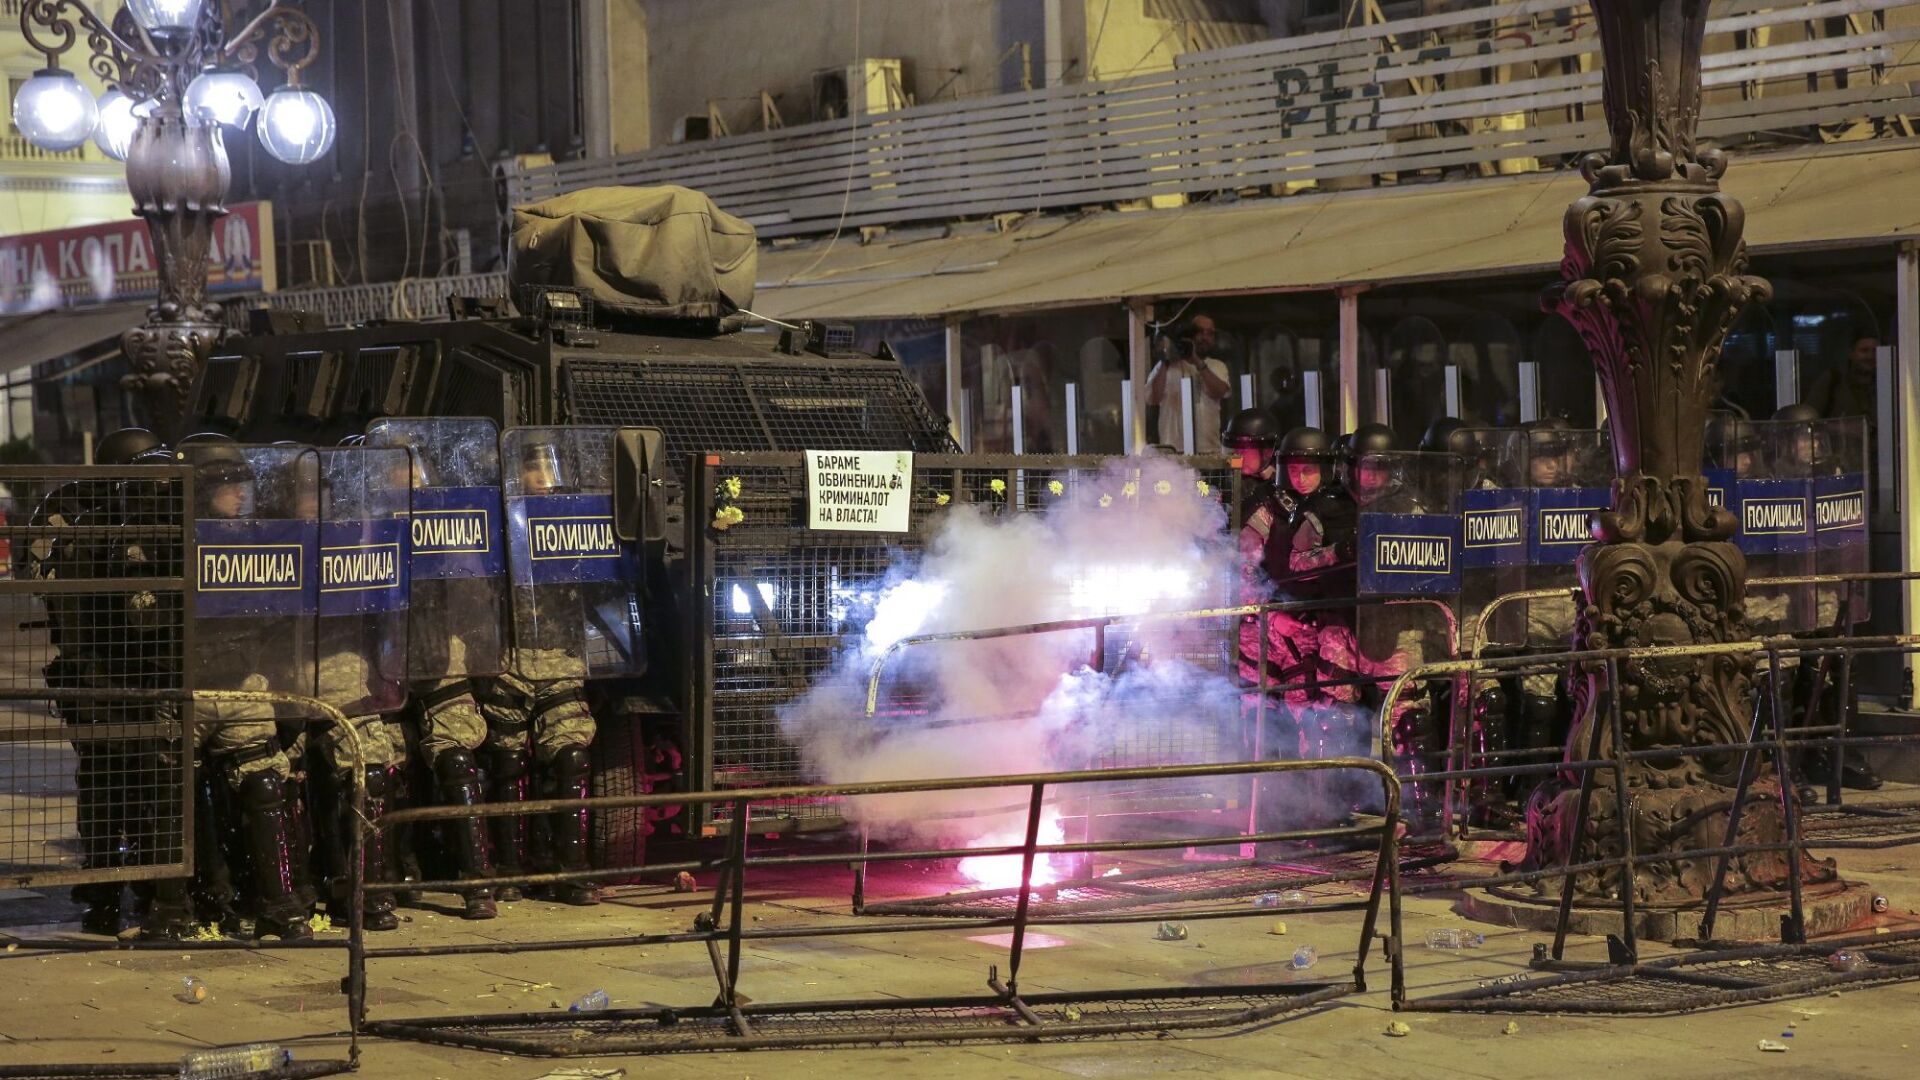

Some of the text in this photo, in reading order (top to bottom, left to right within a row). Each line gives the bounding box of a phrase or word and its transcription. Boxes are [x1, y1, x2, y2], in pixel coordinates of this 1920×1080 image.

[59, 230, 222, 279] КОПАА
[817, 455, 860, 470] БАРАМЕ
[818, 472, 903, 489] ОБВИНЕНИЈА А
[819, 490, 890, 506] КРИМИНАЛОТ
[1816, 497, 1862, 525] ПОЛИЦИЈА
[819, 507, 878, 523] НА ВЛАСТА!
[1468, 514, 1519, 543] ПОЛИЦИЈА
[1545, 514, 1592, 540] ПОЛИЦ
[1747, 504, 1803, 528] ПОЛИЦИЈА
[412, 518, 483, 547] ОЛИЦИЈА
[535, 523, 615, 552] ПОЛИЦИЈА
[323, 551, 395, 584] ПОЛИЦИЈА
[1380, 541, 1446, 567] ПОЛИЦИЈА
[204, 553, 296, 584] ПОЛИЦИЈА
